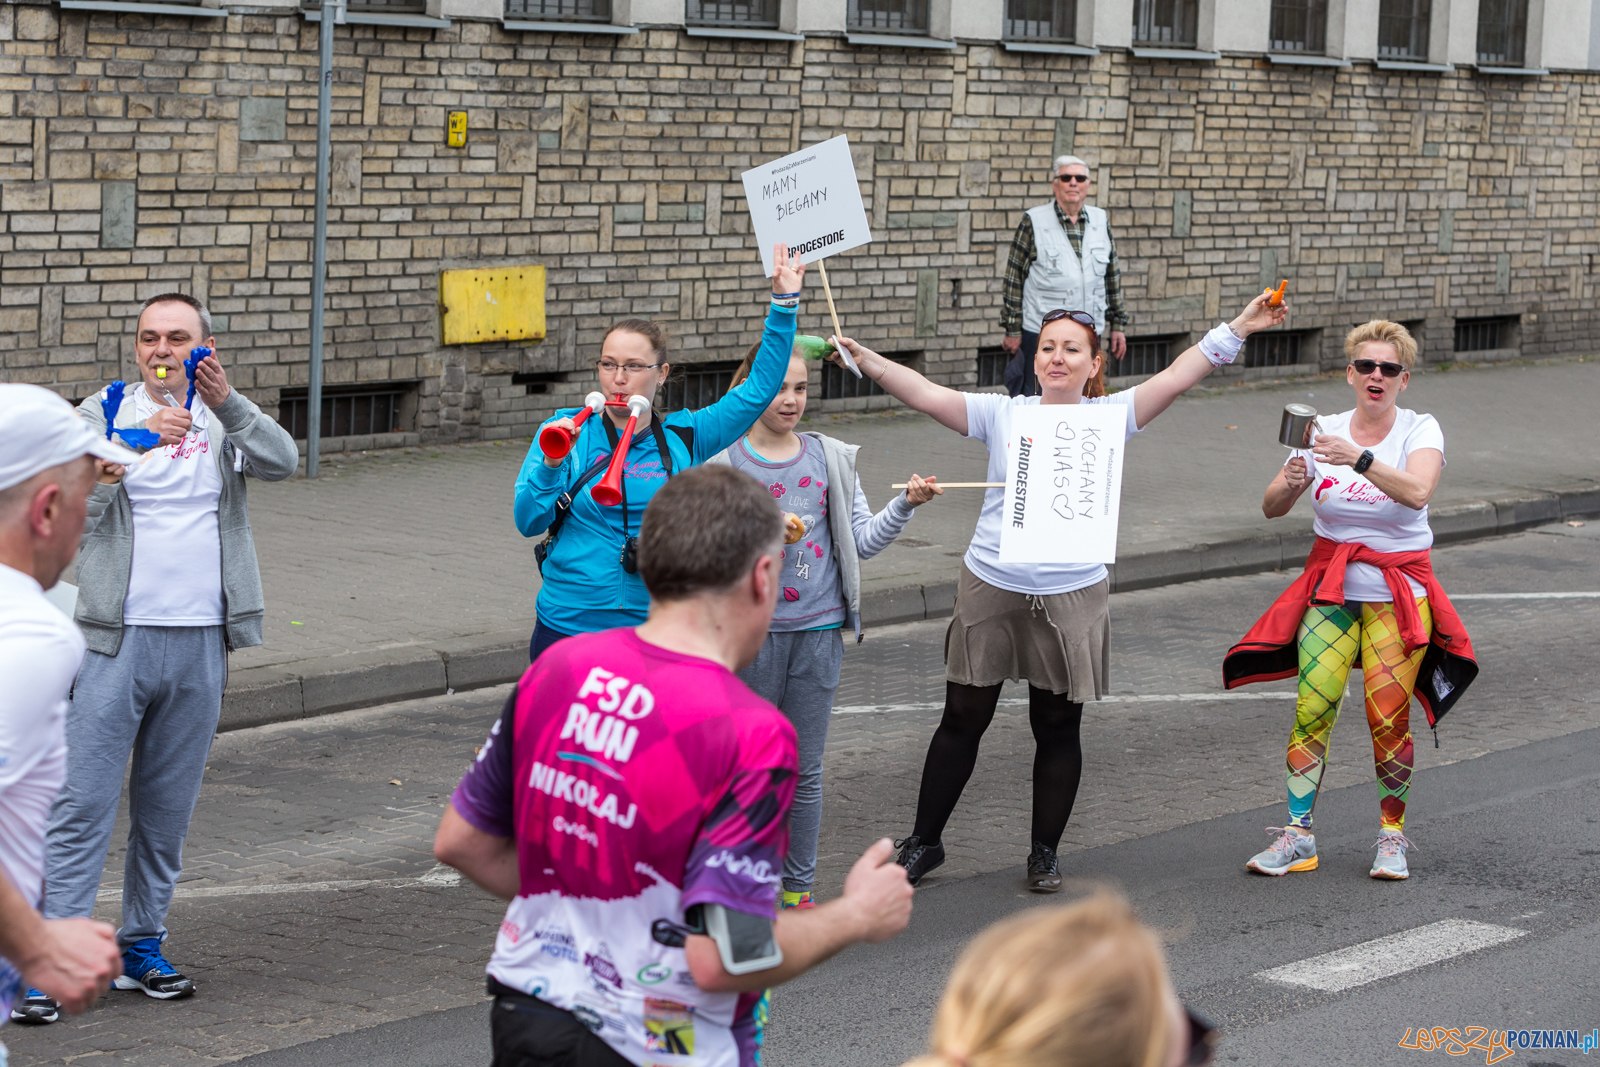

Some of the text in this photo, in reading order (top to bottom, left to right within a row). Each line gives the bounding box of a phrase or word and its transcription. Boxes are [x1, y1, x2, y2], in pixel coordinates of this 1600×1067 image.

[762, 173, 797, 200] MAMY
[775, 187, 828, 222] BIEGAMY
[1012, 435, 1033, 529] BRIDGESTONE
[1053, 447, 1074, 488] WAS
[1078, 427, 1101, 519] KOCHAMY
[788, 495, 810, 509] LOVE
[577, 666, 655, 720] FSD
[560, 702, 640, 763] RUN
[528, 761, 638, 829] NIKOŁAJ
